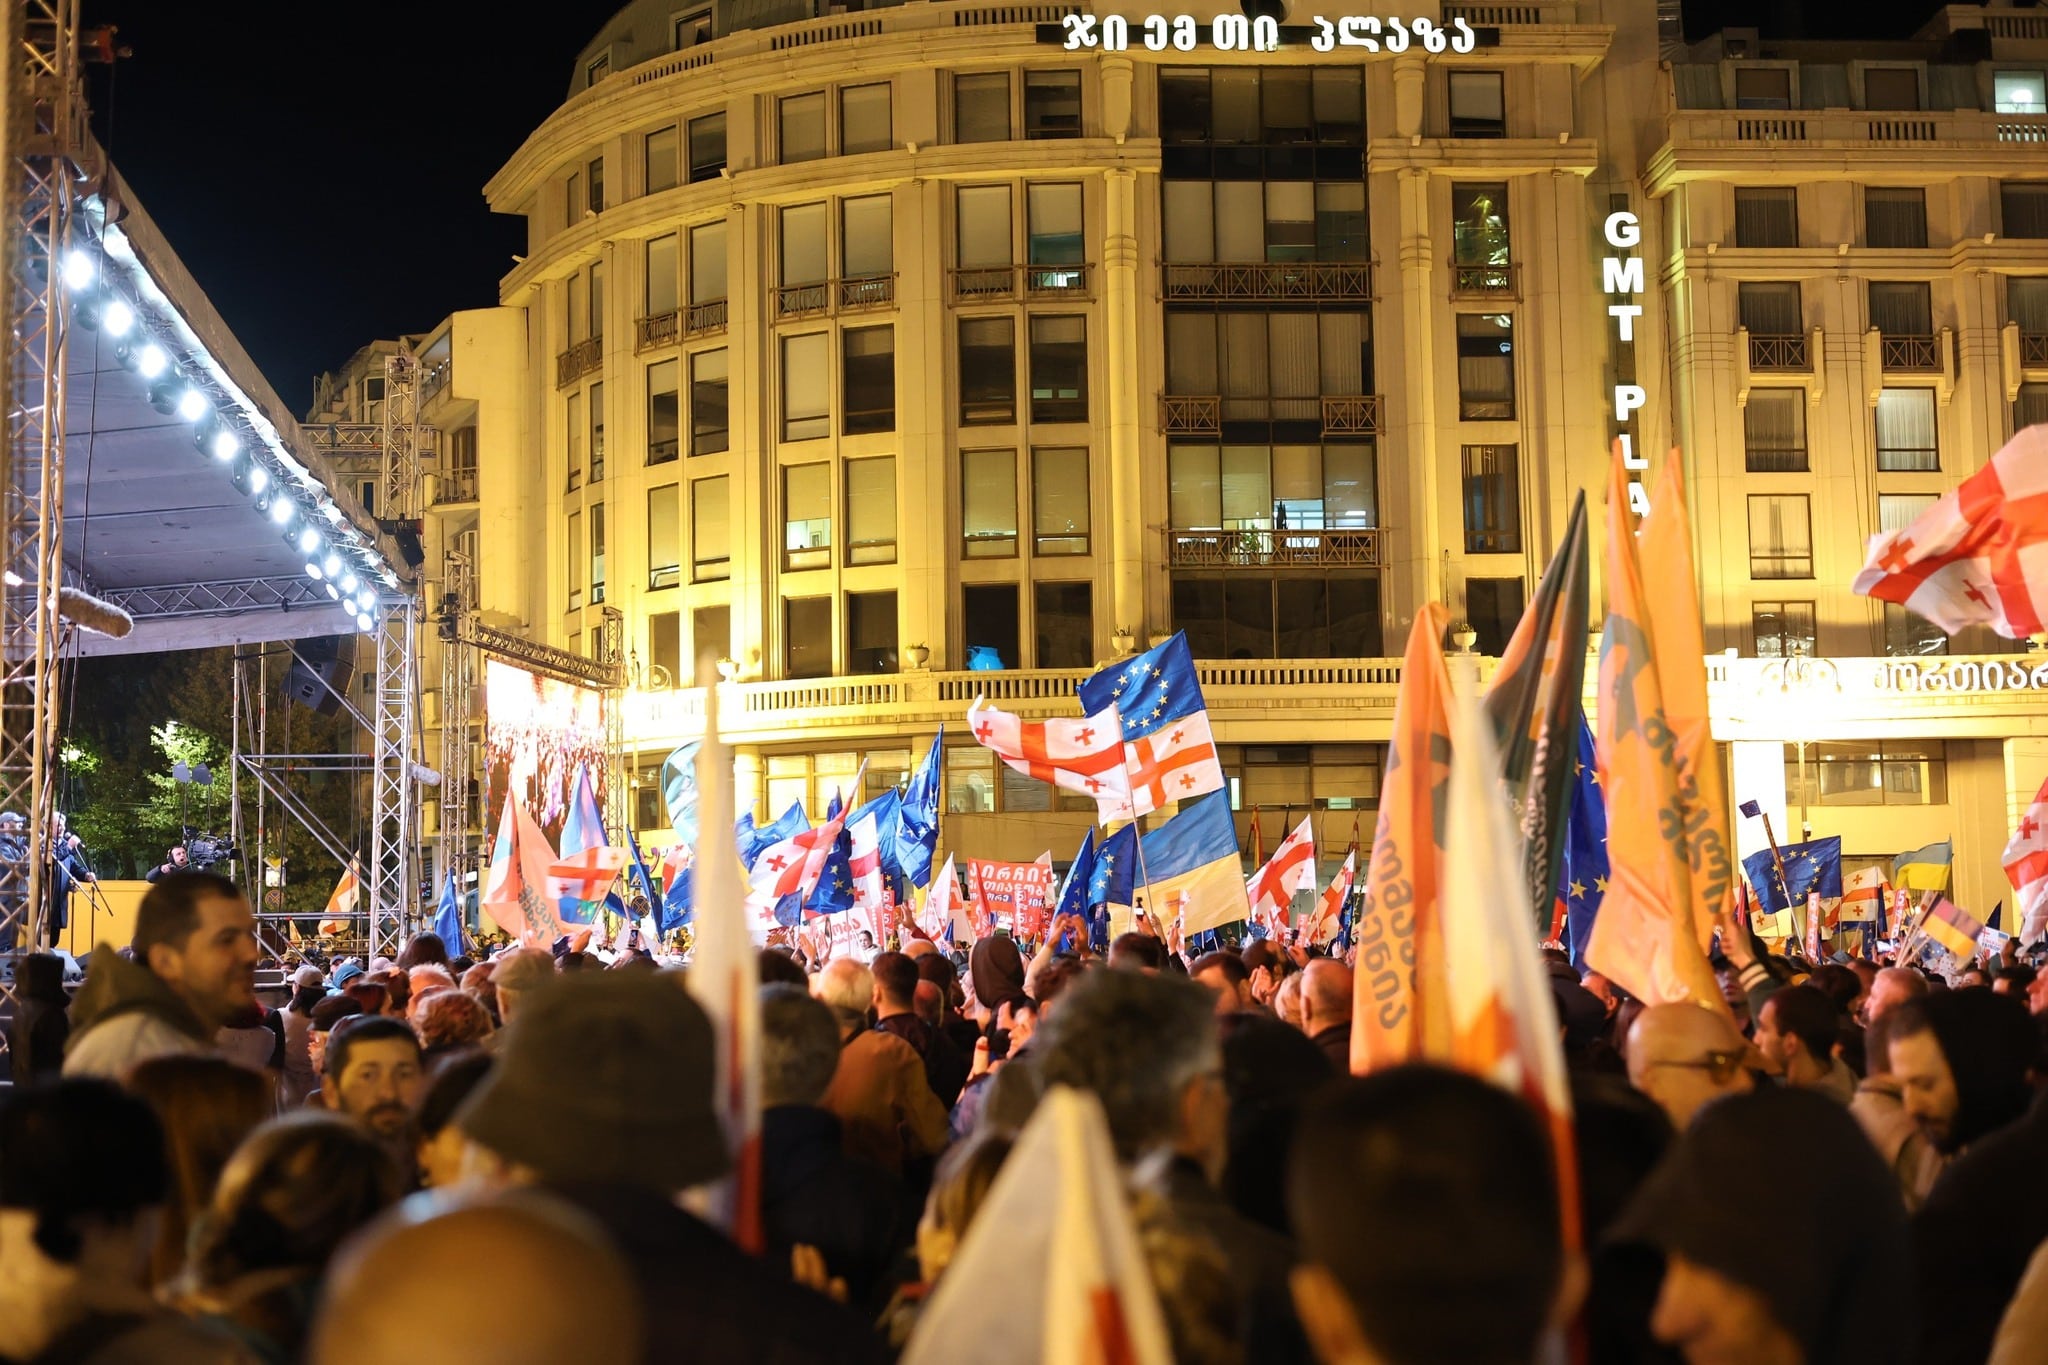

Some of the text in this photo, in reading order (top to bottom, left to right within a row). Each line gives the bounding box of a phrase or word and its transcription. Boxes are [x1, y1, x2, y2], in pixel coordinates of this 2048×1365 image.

[1062, 14, 1476, 54] ჯი ემ თი პლაზა
[1602, 211, 1650, 520] GMT PLA
